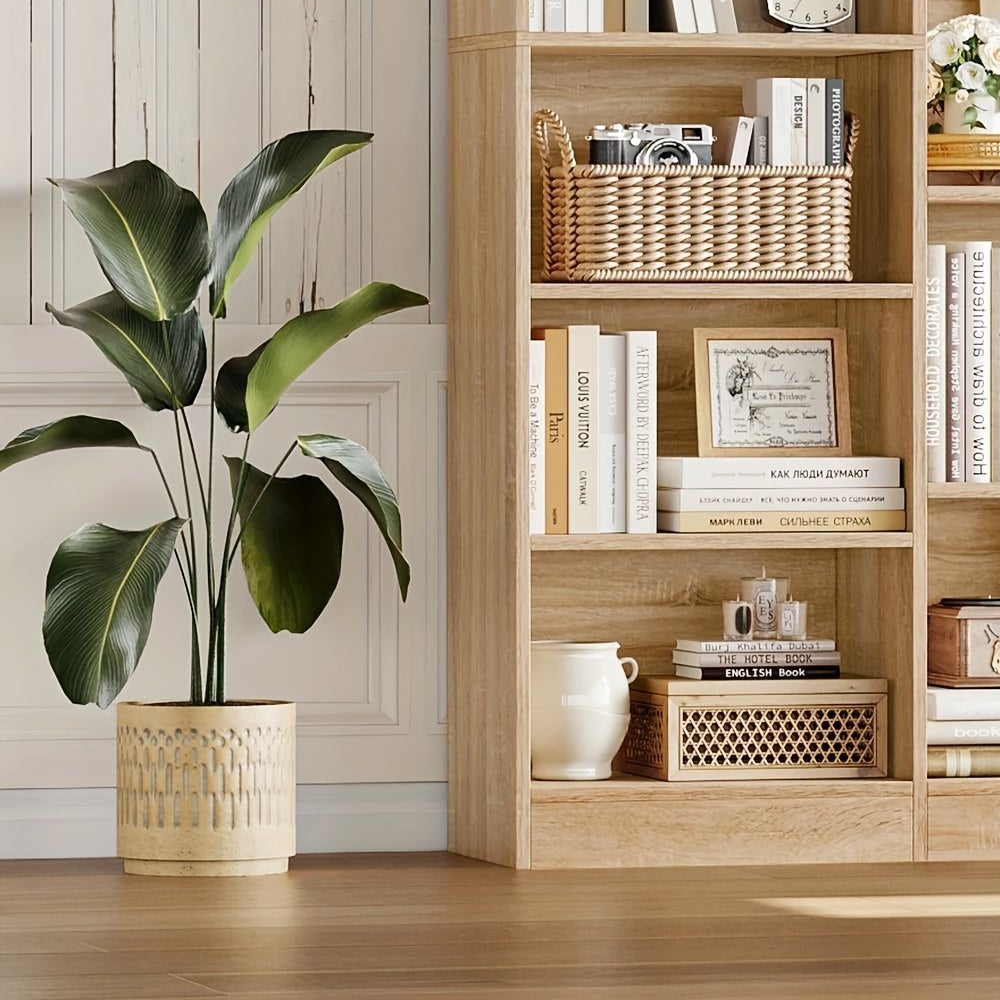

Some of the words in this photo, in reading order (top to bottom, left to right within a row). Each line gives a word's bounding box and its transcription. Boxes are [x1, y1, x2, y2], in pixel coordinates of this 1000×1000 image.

[793, 95, 802, 129] DESIGN
[832, 87, 841, 166] PHOTOGRAPH
[927, 276, 940, 358] DECORATES
[530, 384, 539, 394] To
[577, 371, 590, 402] LOUIS
[636, 345, 650, 412] AFTERWORD
[530, 396, 539, 409] Be
[927, 365, 940, 447] HOUSEHOLD
[548, 411, 564, 445] Paris
[577, 406, 590, 448] VUITTON
[636, 416, 650, 431] BY
[636, 433, 650, 474] DEEPAK
[578, 470, 588, 506] CATWALK
[771, 469, 790, 480] КАК
[793, 469, 824, 480] ЛЮДИ
[826, 469, 869, 480] ДУМАЮТ
[636, 477, 650, 521] CHOPRA
[709, 518, 734, 527] МАРК
[736, 518, 763, 527] ЛЕВИ
[780, 517, 829, 527] СИЛЬНЕЕ
[833, 517, 871, 527] СТРАХА
[718, 655, 736, 665] THE
[744, 654, 778, 664] HOTEL
[785, 654, 813, 664] BOOK
[738, 642, 782, 651] Khalifa
[725, 669, 772, 678] ENGLISH
[779, 668, 805, 677] Book
[954, 725, 1000, 738] book
